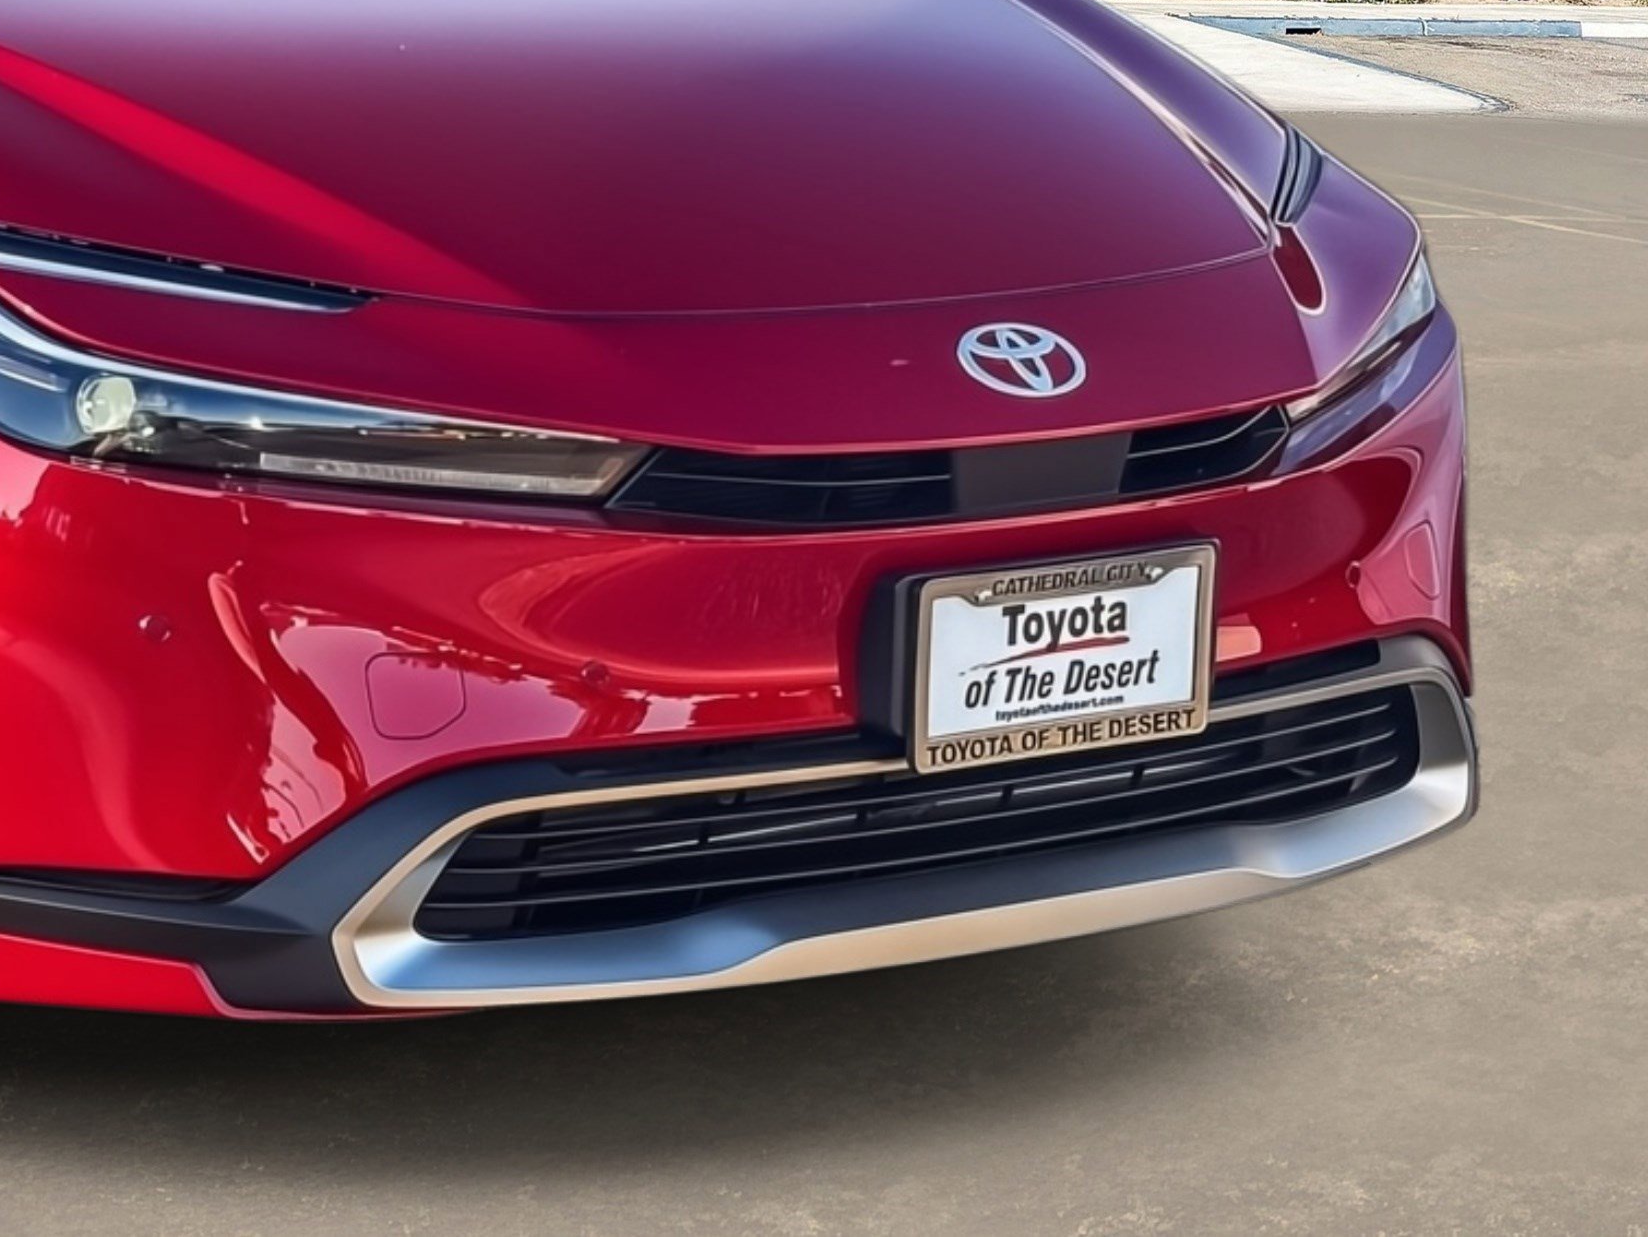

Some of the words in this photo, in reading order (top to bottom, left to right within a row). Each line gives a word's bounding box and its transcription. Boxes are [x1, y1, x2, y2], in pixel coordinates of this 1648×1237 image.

[992, 568, 1101, 597] CATHEDRAL
[1107, 561, 1147, 582] CITY
[1002, 596, 1128, 651] Toyota
[965, 670, 997, 709] of
[1004, 664, 1054, 704] The
[1063, 649, 1161, 696] Desert
[927, 735, 1014, 766] TOYOTA
[1021, 728, 1051, 752] OF
[1057, 721, 1103, 746] THE
[1108, 708, 1197, 739] DESERT
